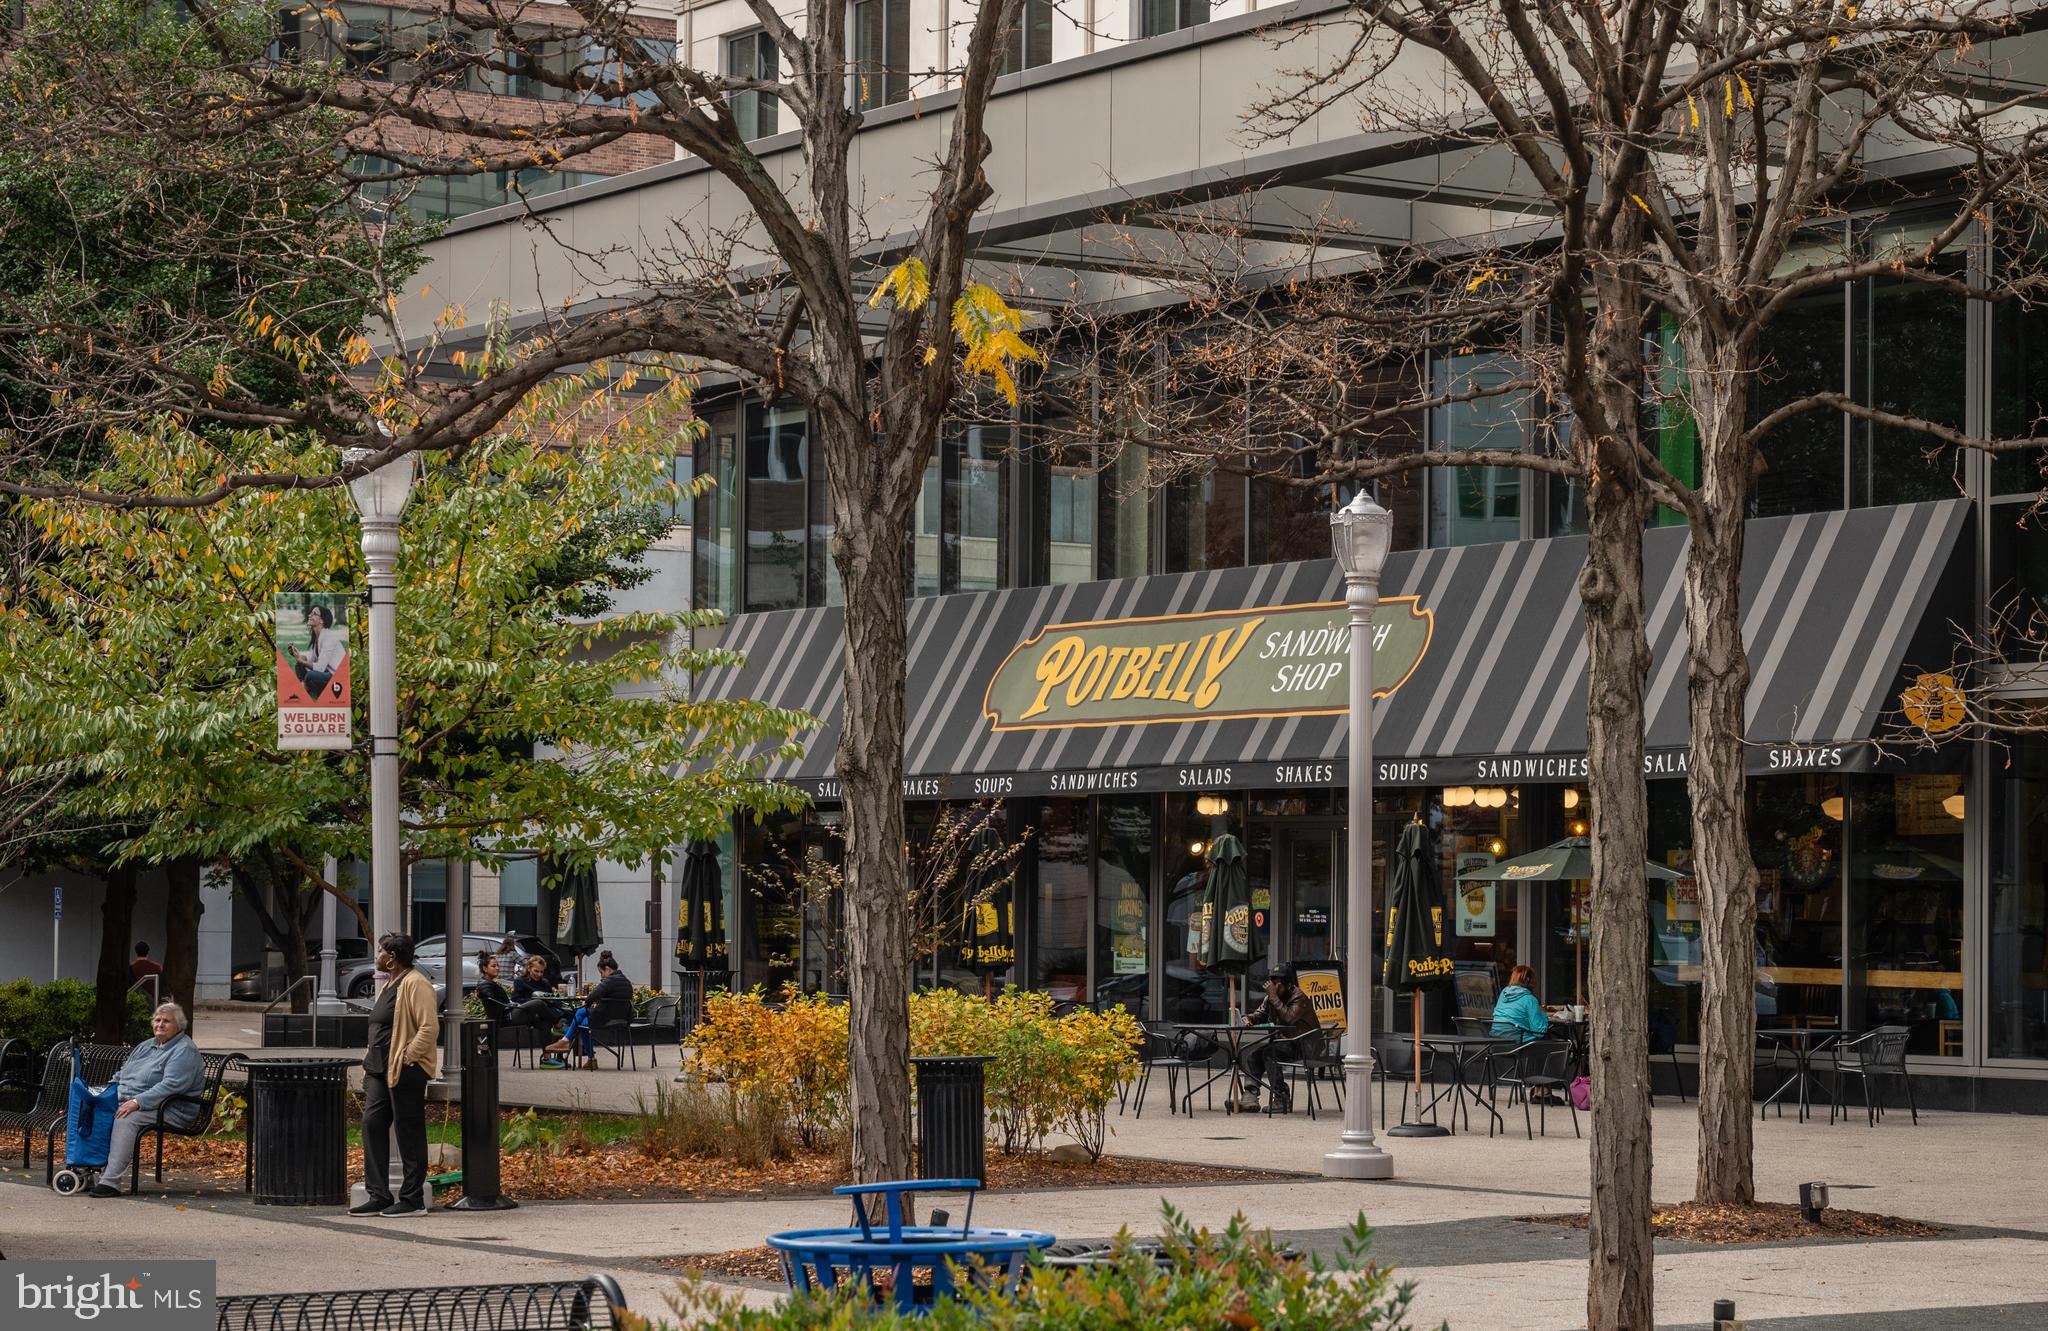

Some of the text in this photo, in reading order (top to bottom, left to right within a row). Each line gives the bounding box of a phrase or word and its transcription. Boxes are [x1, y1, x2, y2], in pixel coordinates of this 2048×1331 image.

[1259, 623, 1392, 660] SANDWH
[1019, 616, 1266, 720] POTBELLY
[1271, 662, 1343, 693] SHOP
[284, 713, 346, 722] WELBURN
[284, 724, 346, 733] SQUARE
[818, 748, 1842, 797] SAL HAKES SOUPS SANDWICHES SALADS SHAKES SOUPS SANDWICHES SALA SHAKES
[1311, 992, 1342, 1011] RING
